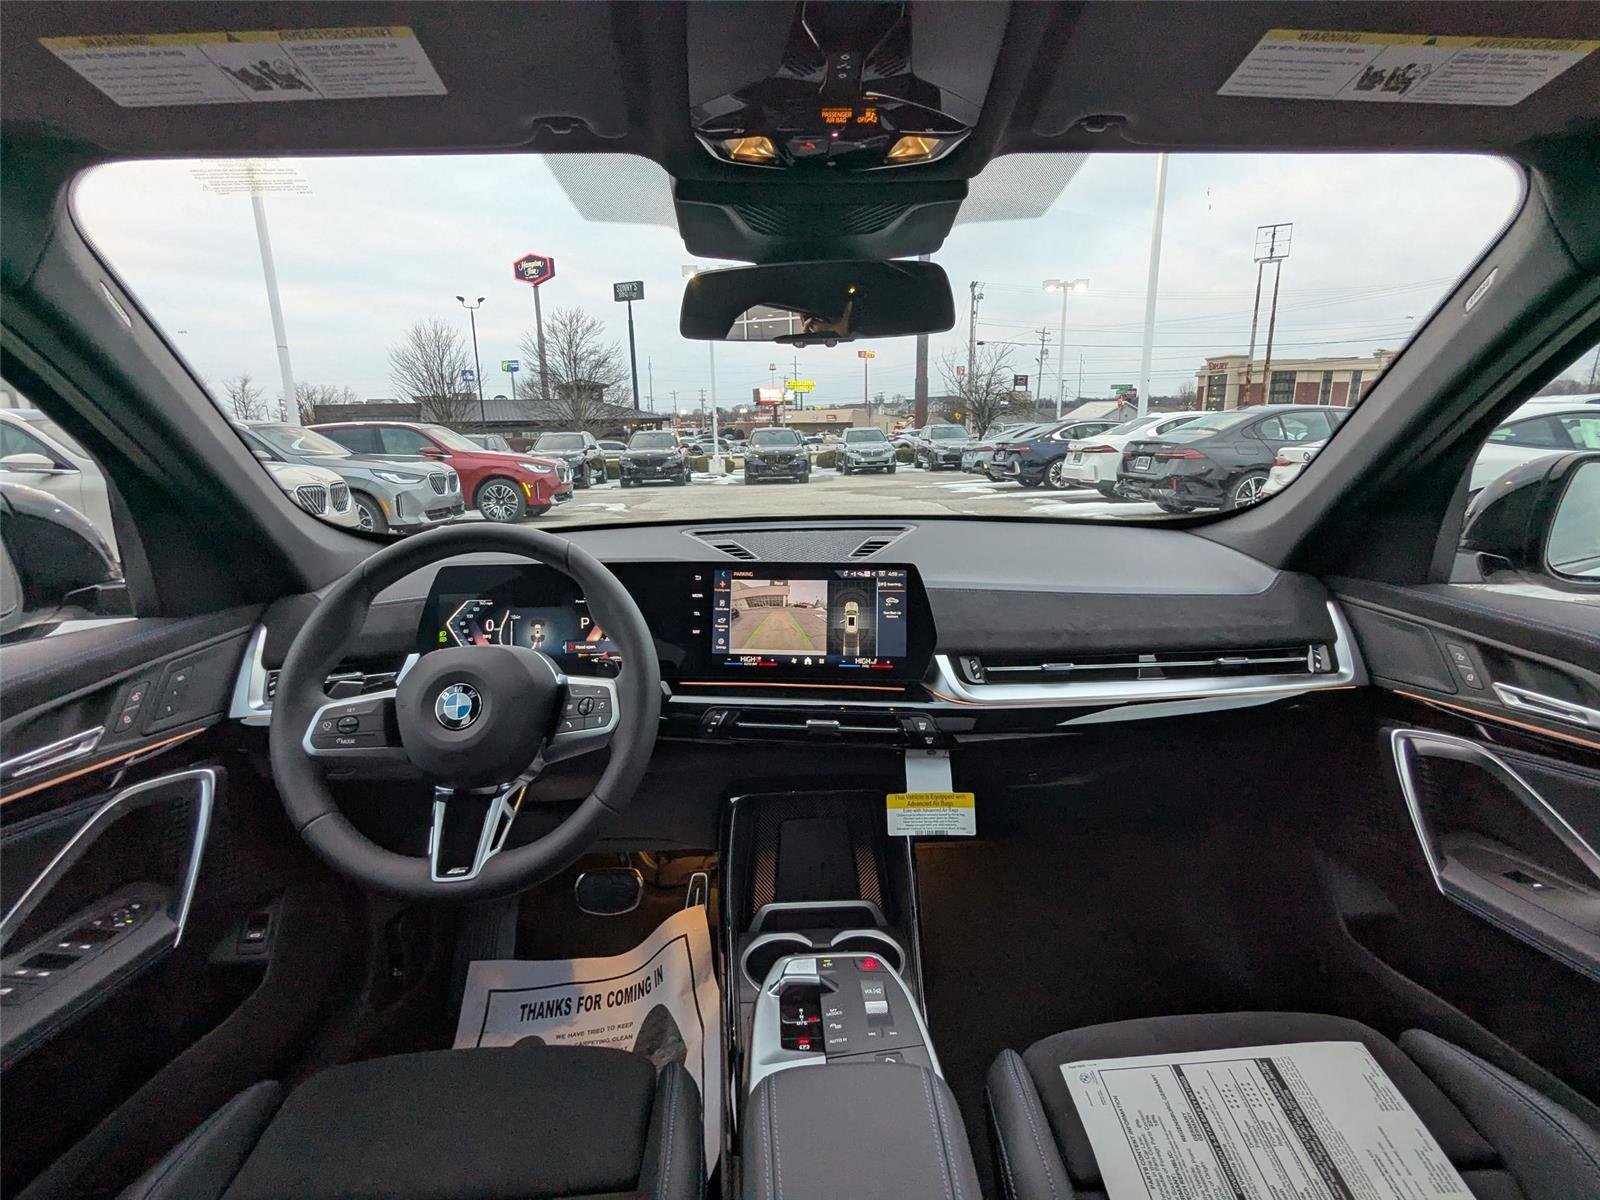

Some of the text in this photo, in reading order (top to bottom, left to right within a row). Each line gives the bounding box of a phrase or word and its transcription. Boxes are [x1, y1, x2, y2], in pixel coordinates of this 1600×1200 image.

[486, 619, 495, 632] 0
[581, 617, 590, 629] P
[519, 965, 664, 1022] THANKS FOR COMING IN
[567, 1030, 585, 1038] HAVE
[587, 1027, 605, 1035] TRIED
[617, 1022, 634, 1031] KEEP
[612, 1034, 633, 1042] CLEAN
[1150, 1073, 1167, 1099] GERMANY
[1112, 1095, 1156, 1189] PARTS CONTENT INFORMATION
